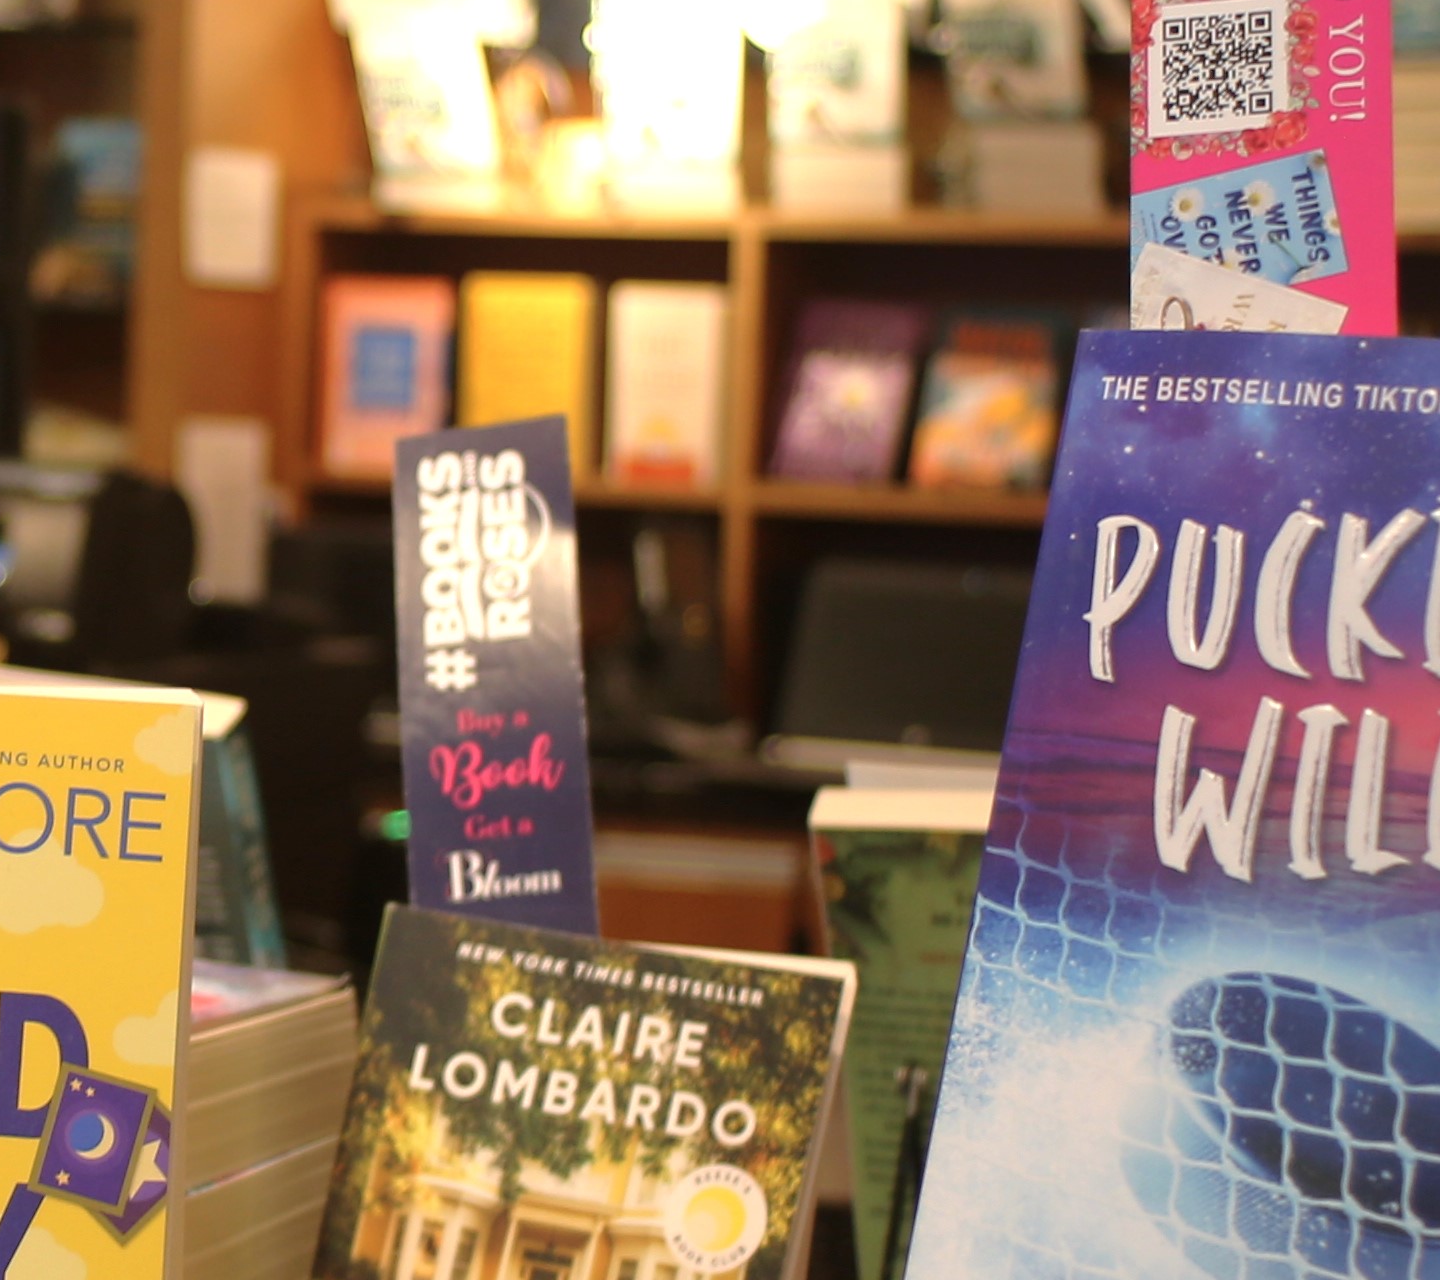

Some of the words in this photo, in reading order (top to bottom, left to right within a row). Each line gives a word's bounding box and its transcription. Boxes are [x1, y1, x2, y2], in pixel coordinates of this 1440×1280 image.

[1328, 14, 1368, 124] YOU!
[1224, 189, 1262, 275] NEVER
[1264, 202, 1290, 243] WE
[1291, 166, 1330, 265] THINGS
[1101, 375, 1148, 401] THE
[1155, 376, 1344, 409] BESTSELLING
[457, 709, 506, 734] Buy
[38, 753, 126, 773] AUTHOR
[430, 732, 566, 810] Book
[465, 815, 513, 842] Get
[446, 849, 562, 904] Bloom
[456, 940, 506, 965] NEW
[511, 949, 569, 977] YORK
[574, 960, 636, 988] TIMES
[639, 970, 766, 1009] BESTSELLER
[491, 990, 709, 1069] CLAIRE
[408, 1042, 757, 1147] LOMBARDO
